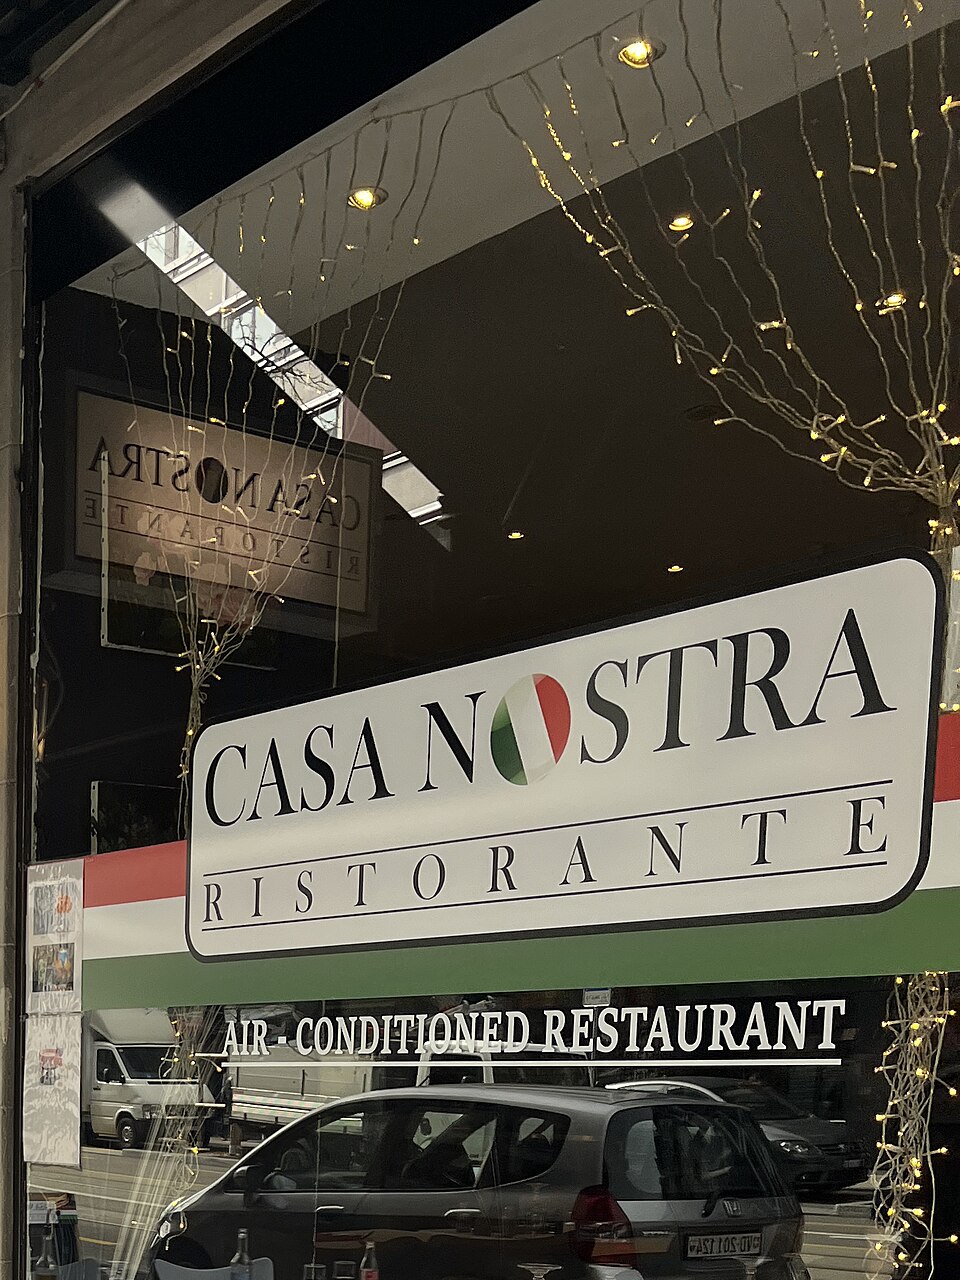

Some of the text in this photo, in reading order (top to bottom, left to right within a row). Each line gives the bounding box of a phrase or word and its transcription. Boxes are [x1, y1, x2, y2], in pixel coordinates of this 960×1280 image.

[204, 607, 898, 827] CASA NOSTRA
[201, 795, 889, 924] RISTORANTE
[222, 1020, 270, 1057] AIR
[296, 1010, 531, 1056] CONDITIONED
[541, 999, 846, 1054] RESTAURANT
